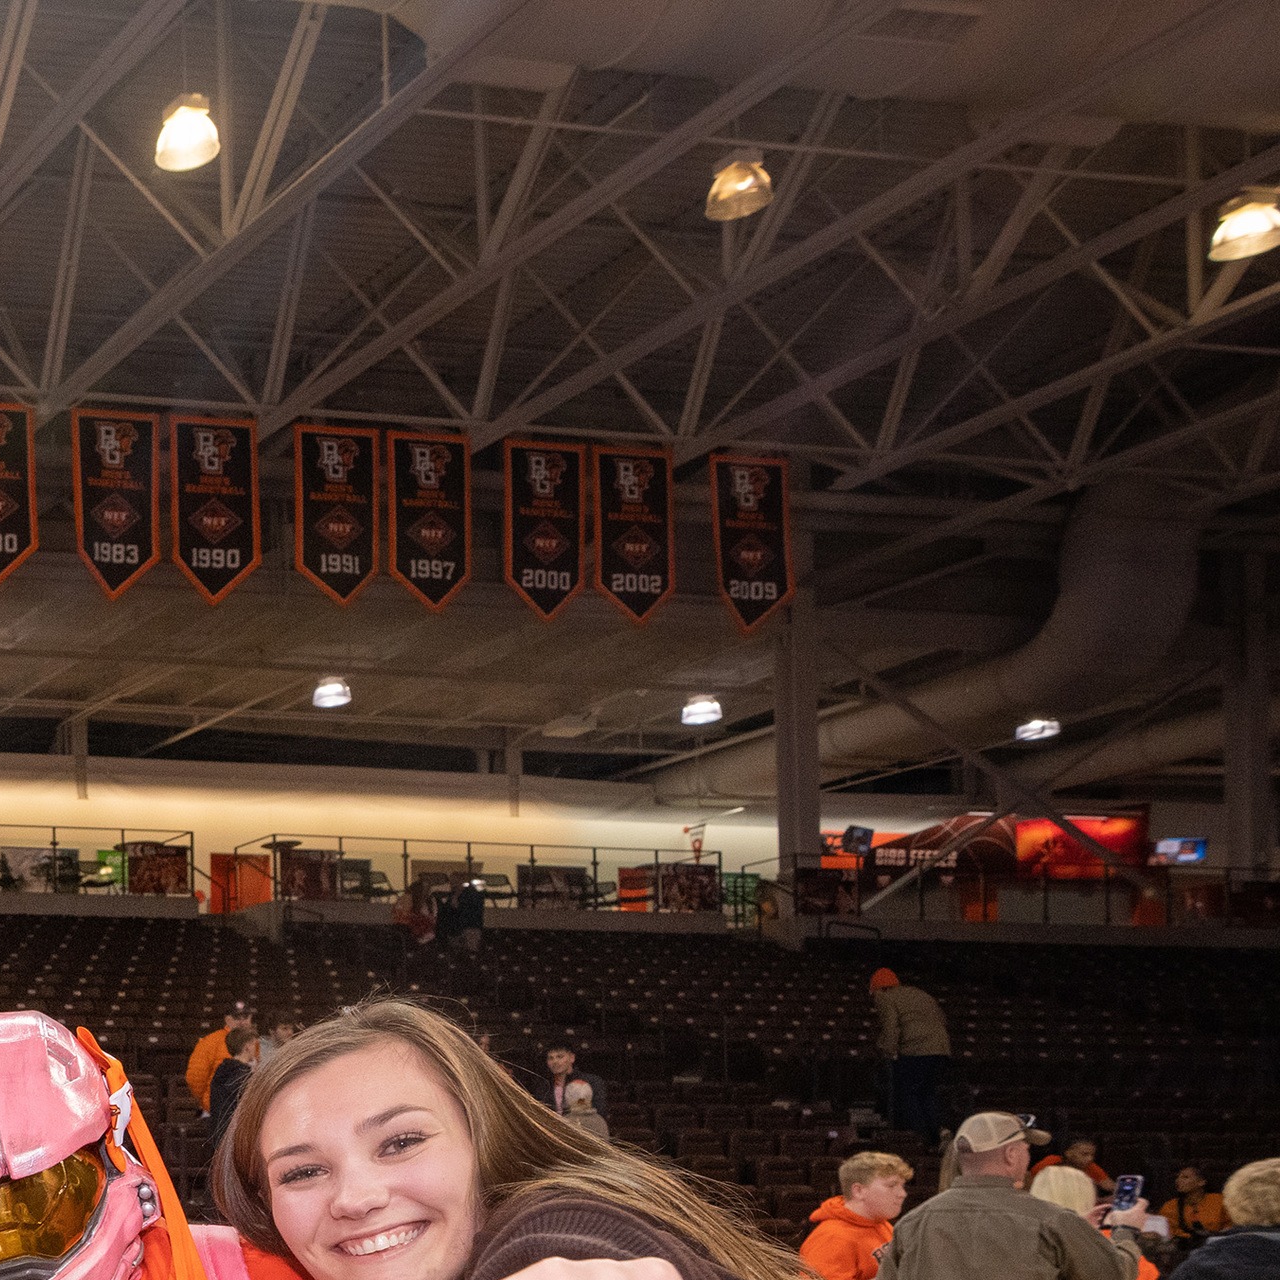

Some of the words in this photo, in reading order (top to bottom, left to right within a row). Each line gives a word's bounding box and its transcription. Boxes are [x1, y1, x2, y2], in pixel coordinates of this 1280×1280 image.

[93, 542, 139, 564] 1983
[191, 547, 241, 569] 1990
[320, 553, 361, 575] 1991
[410, 558, 456, 580] 1997
[521, 569, 571, 591] 2000
[612, 572, 663, 594] 2002
[729, 579, 778, 601] 2009
[875, 848, 906, 866] BIRD
